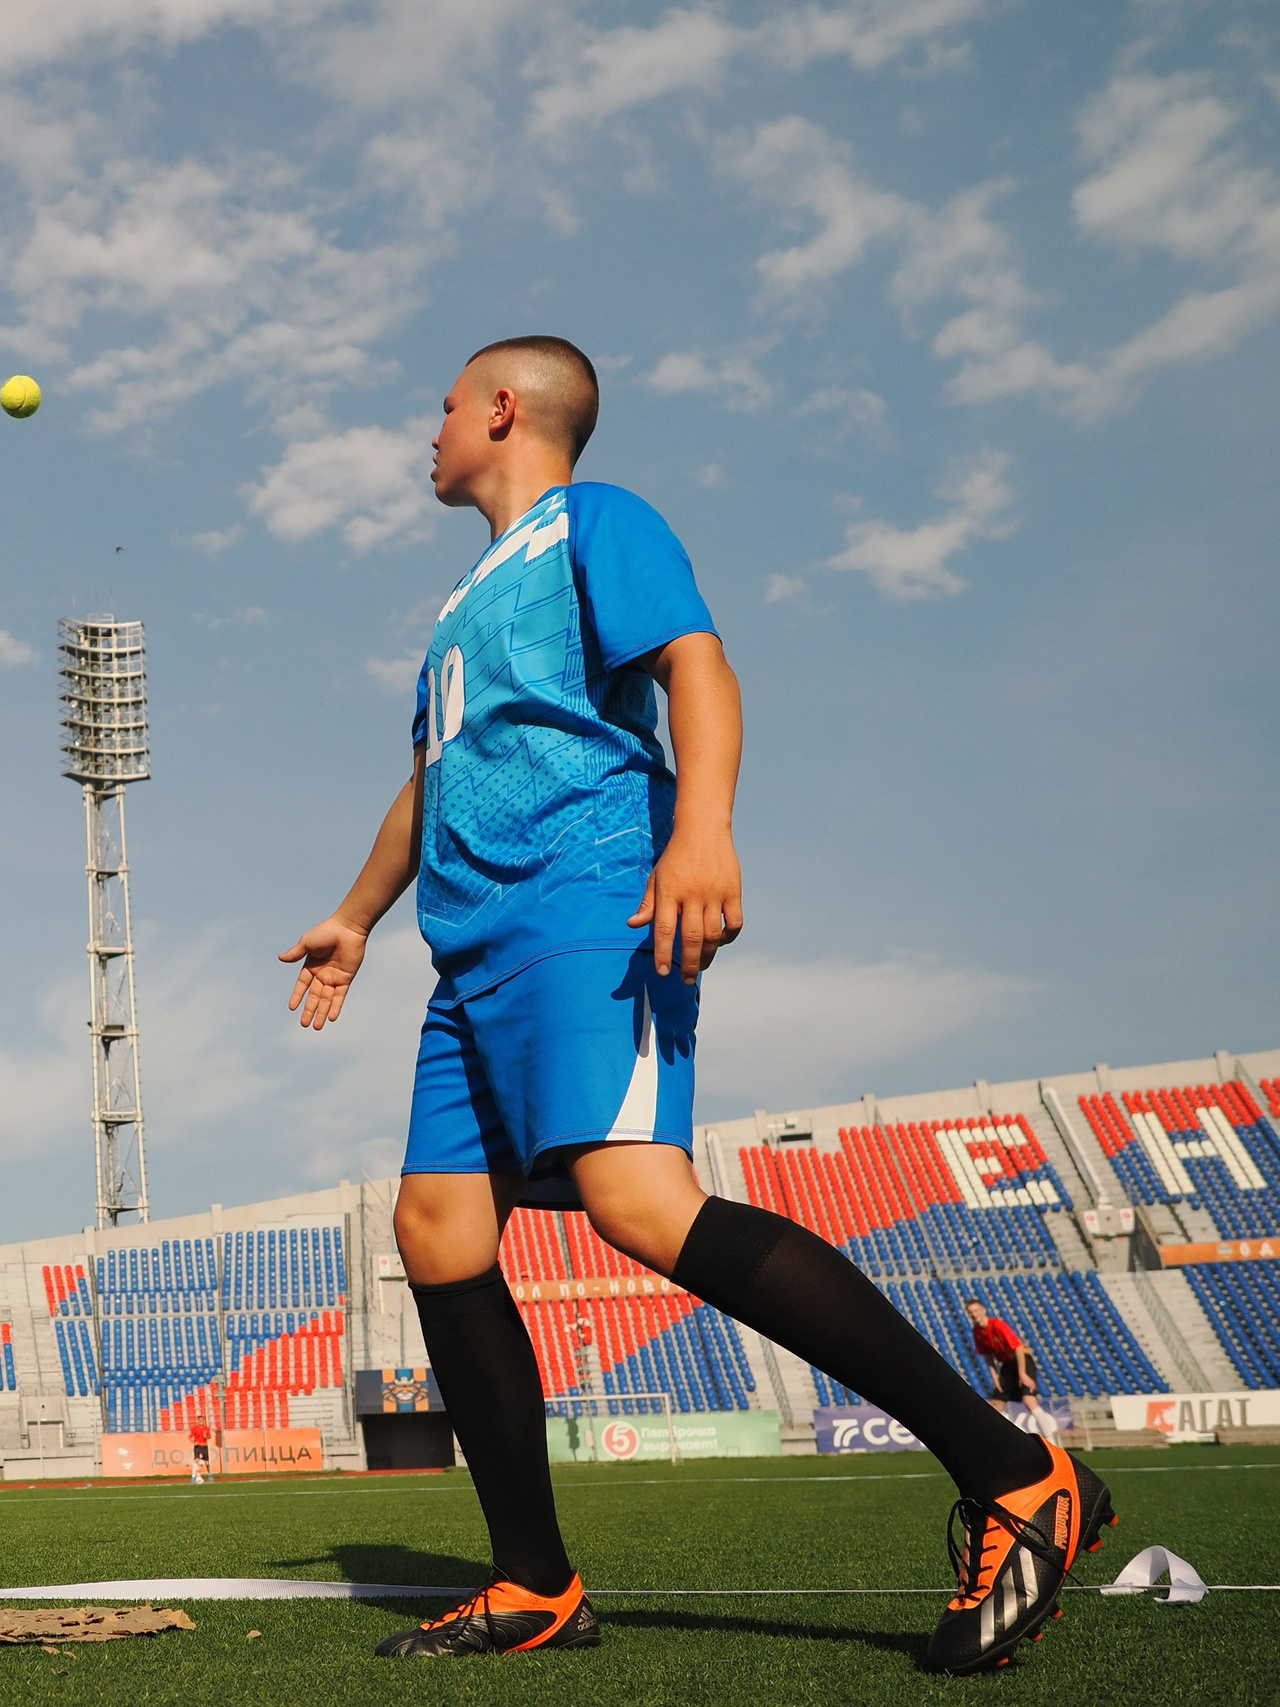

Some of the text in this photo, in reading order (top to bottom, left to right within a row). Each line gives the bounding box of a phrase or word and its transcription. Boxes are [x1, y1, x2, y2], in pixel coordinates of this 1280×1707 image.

[426, 644, 466, 768] 10
[559, 1279, 686, 1296] ПО-НОВО
[1179, 1399, 1250, 1433] АГАТ
[611, 1425, 630, 1451] 5
